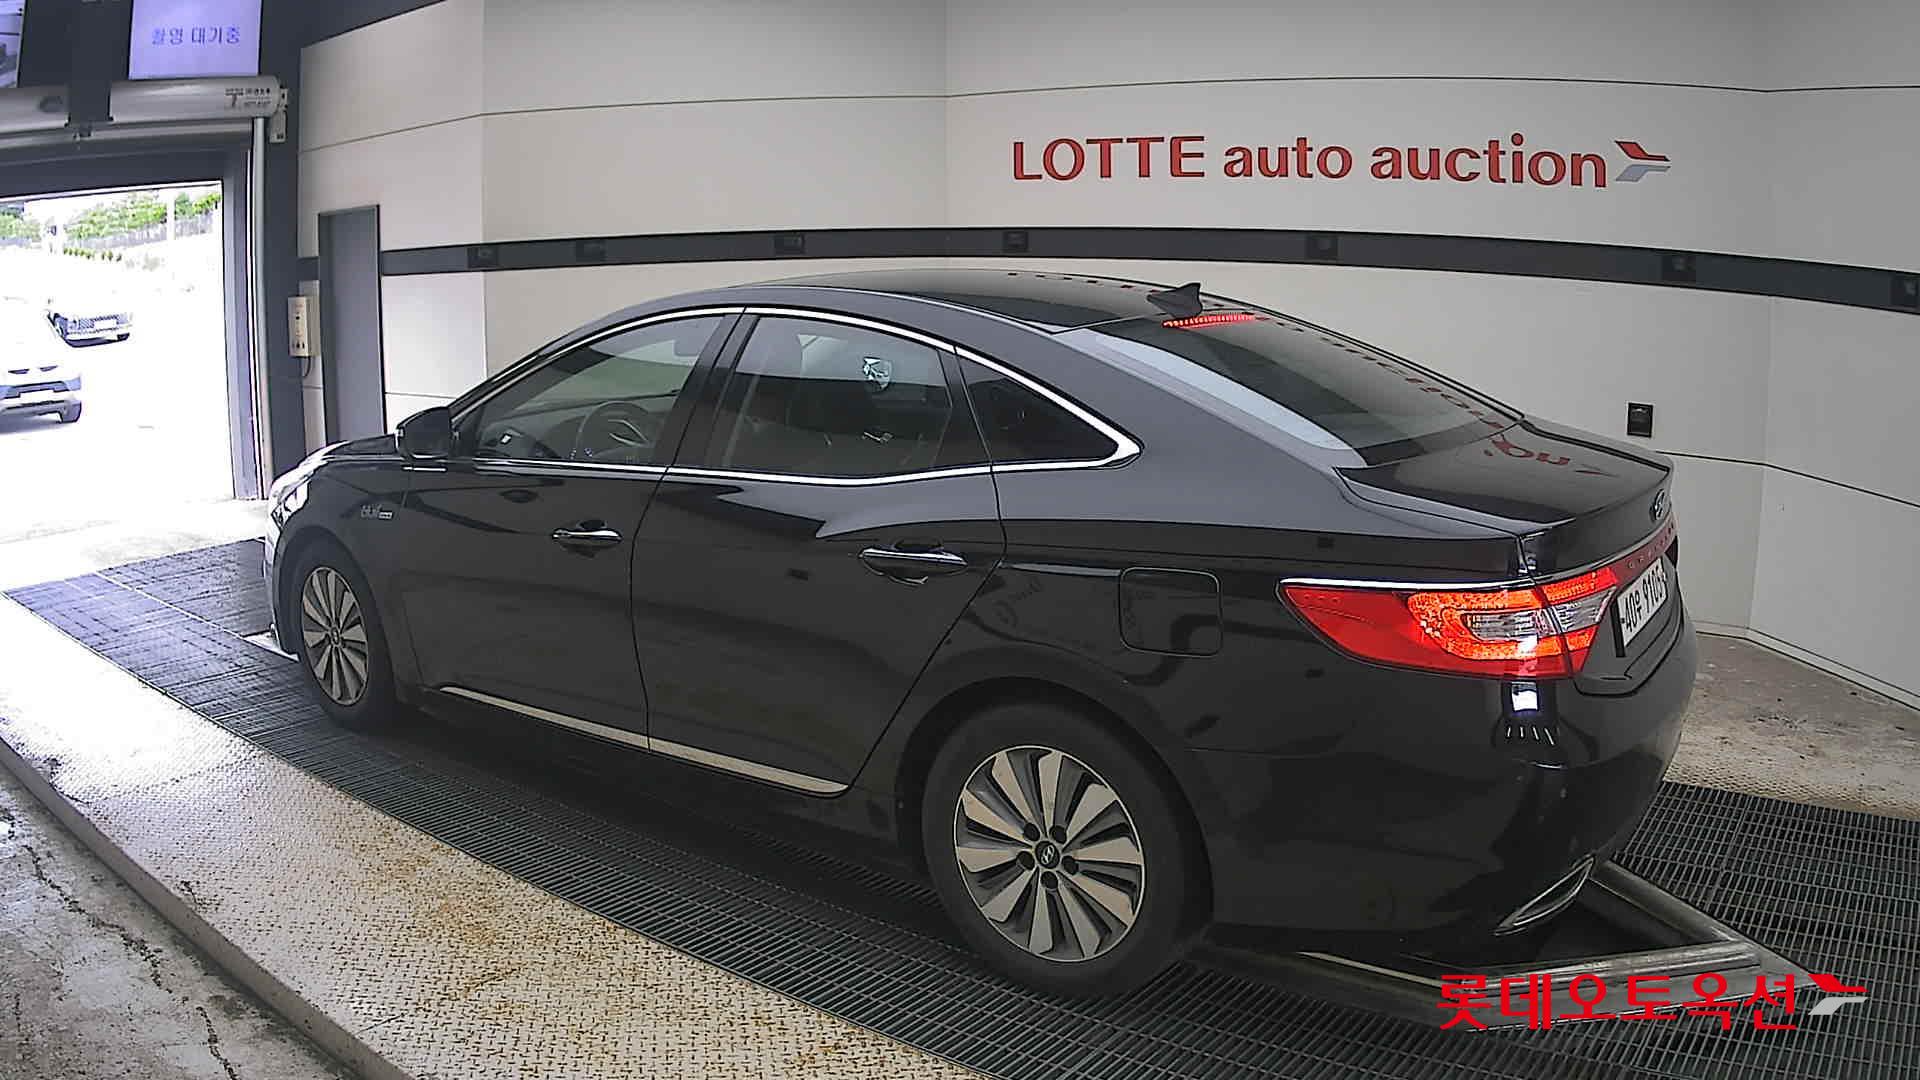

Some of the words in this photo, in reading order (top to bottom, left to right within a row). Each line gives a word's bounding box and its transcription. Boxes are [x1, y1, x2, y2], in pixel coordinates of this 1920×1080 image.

[191, 26, 240, 44] 대기중
[1012, 135, 1206, 182] LOTTE
[1223, 136, 1353, 181] auto
[1370, 132, 1607, 189] auction
